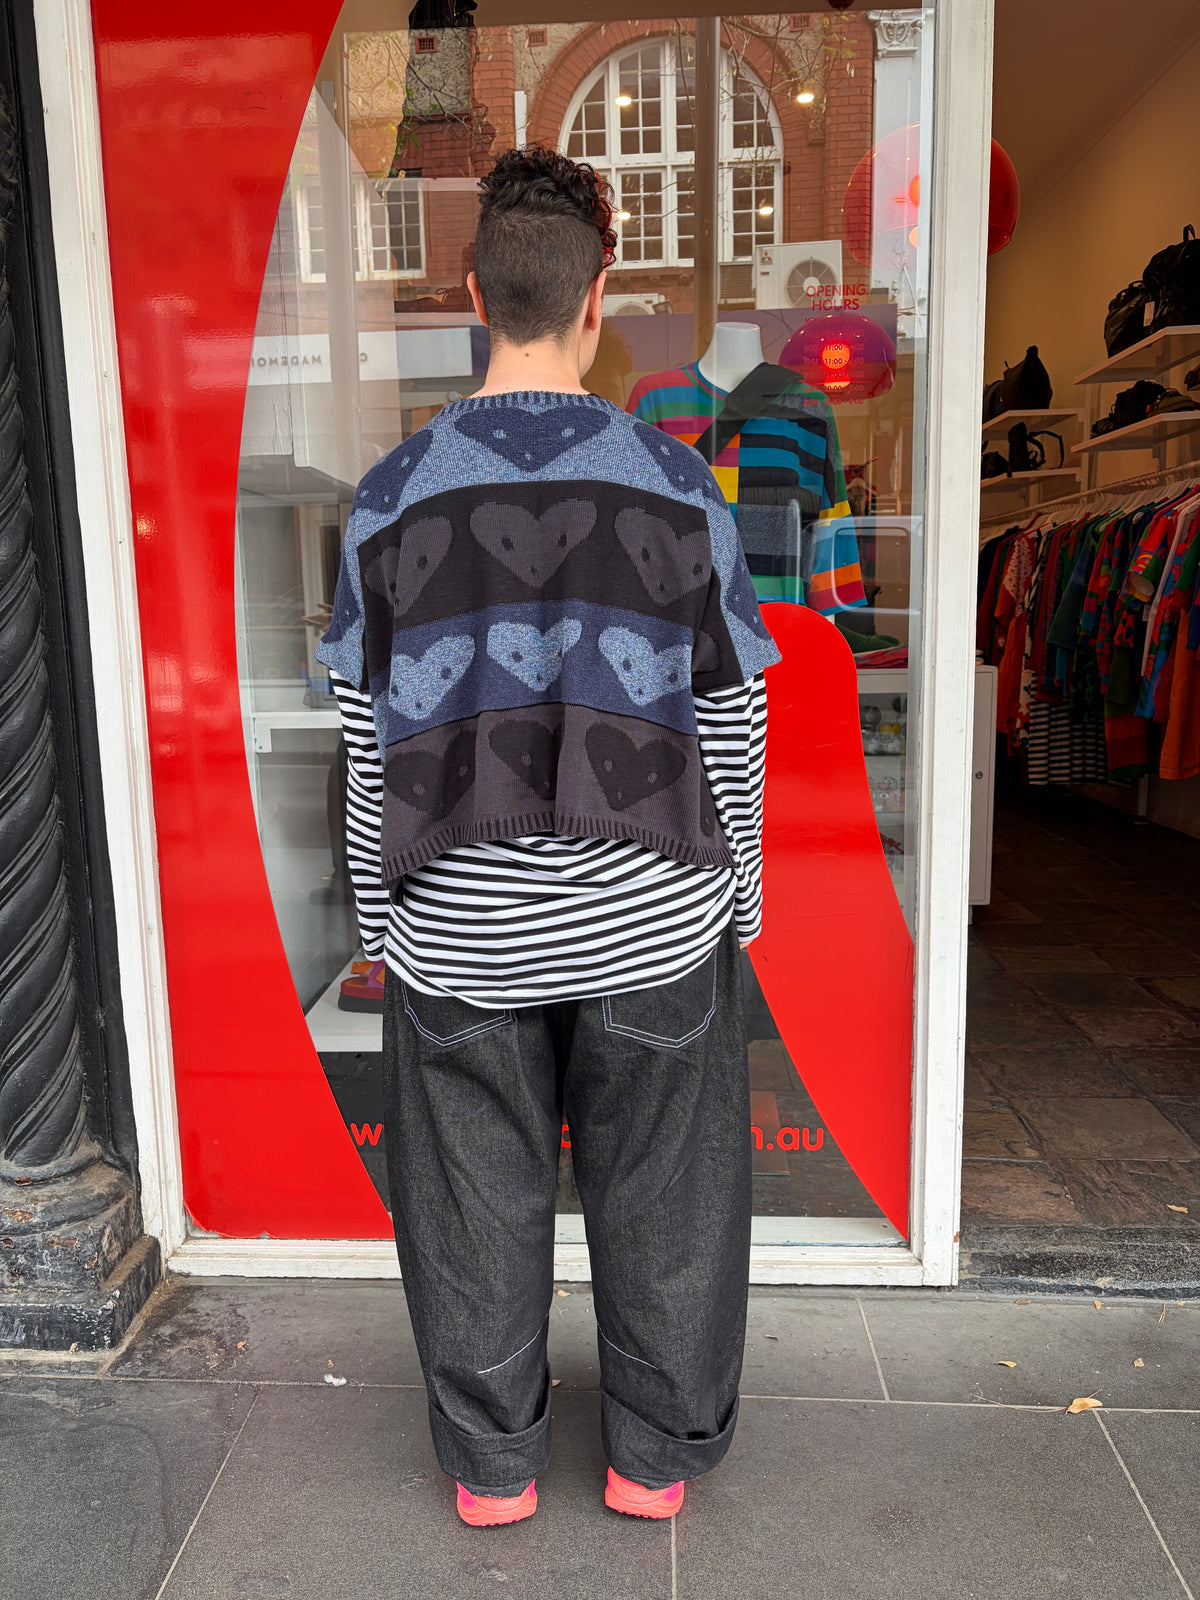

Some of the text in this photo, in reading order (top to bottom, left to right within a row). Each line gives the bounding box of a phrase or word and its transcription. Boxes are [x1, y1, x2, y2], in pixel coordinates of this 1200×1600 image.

[805, 283, 866, 297] OPENING
[811, 298, 860, 311] HOURS
[803, 399, 818, 407] SUN
